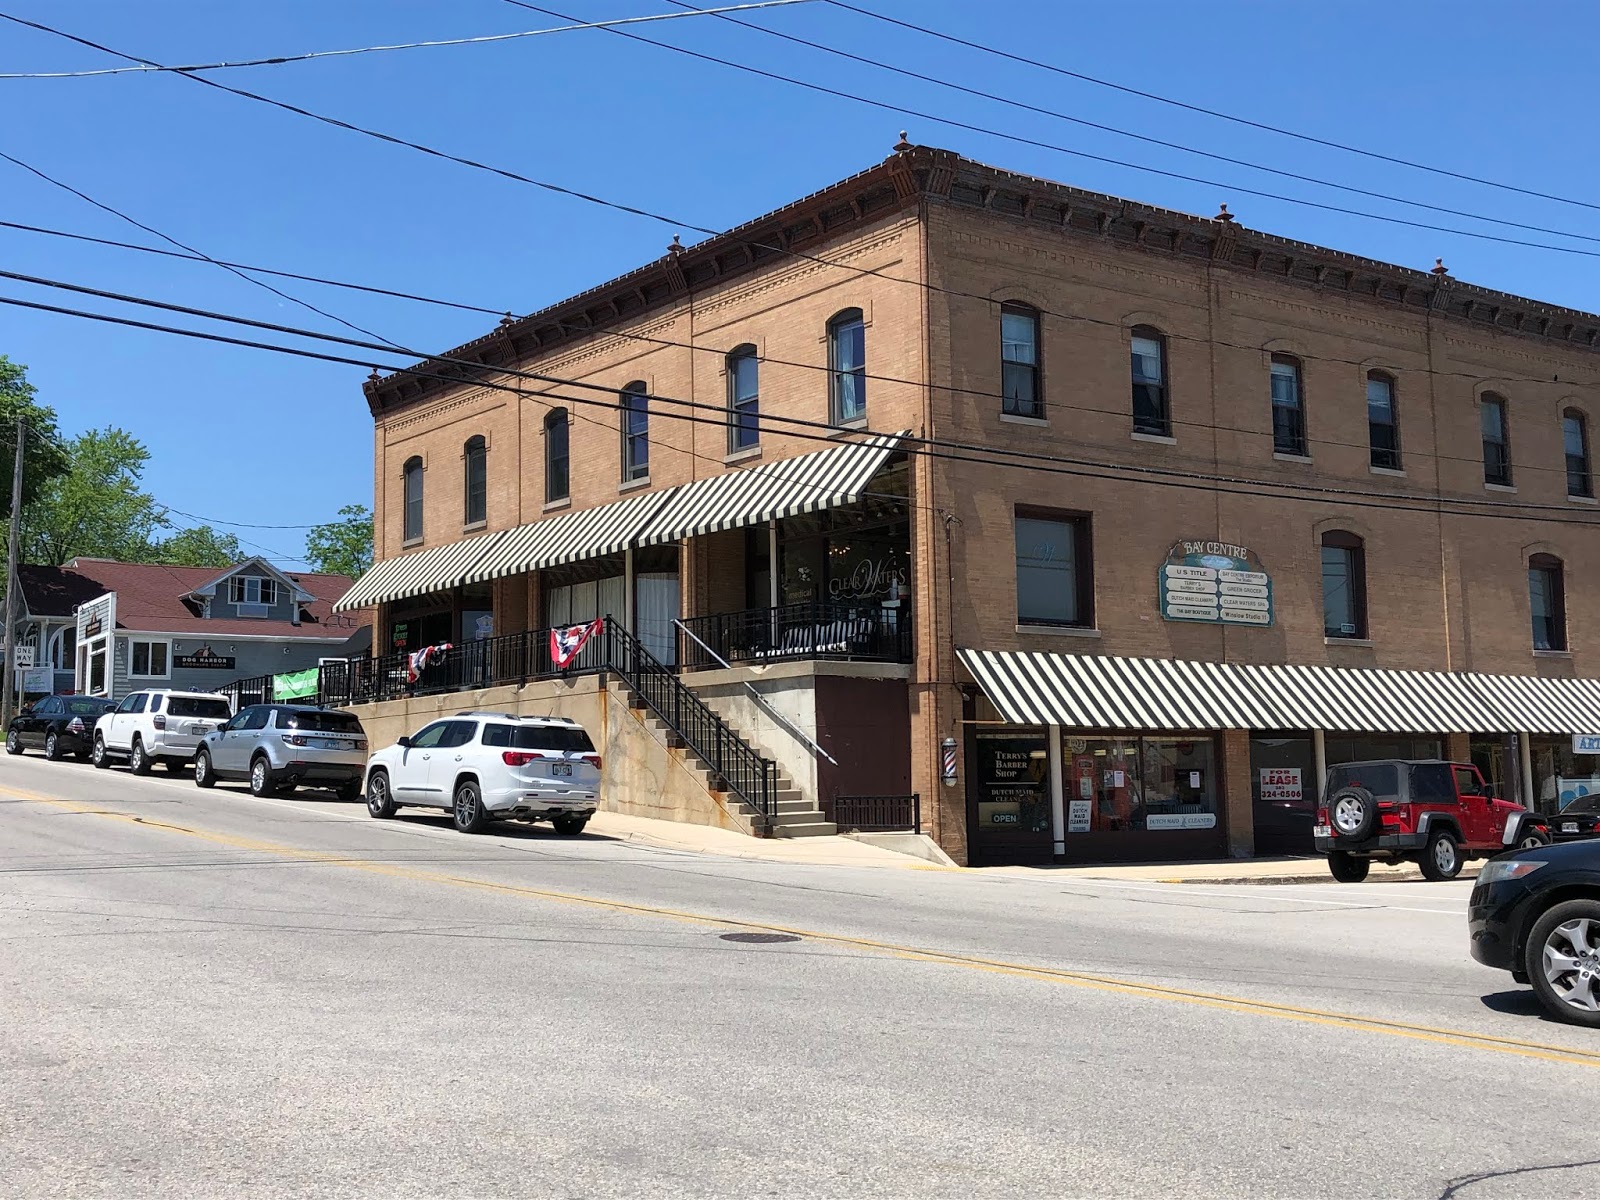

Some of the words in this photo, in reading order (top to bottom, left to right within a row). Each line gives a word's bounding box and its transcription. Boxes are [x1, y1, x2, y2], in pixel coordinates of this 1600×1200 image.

[1184, 541, 1204, 555] BAY
[1206, 541, 1248, 560] CENTRE
[829, 576, 860, 594] CLEAR
[995, 751, 1028, 759] TERRY'S
[996, 760, 1027, 768] BARBER
[995, 769, 1017, 777] SHOP
[1262, 776, 1298, 785] LEASE
